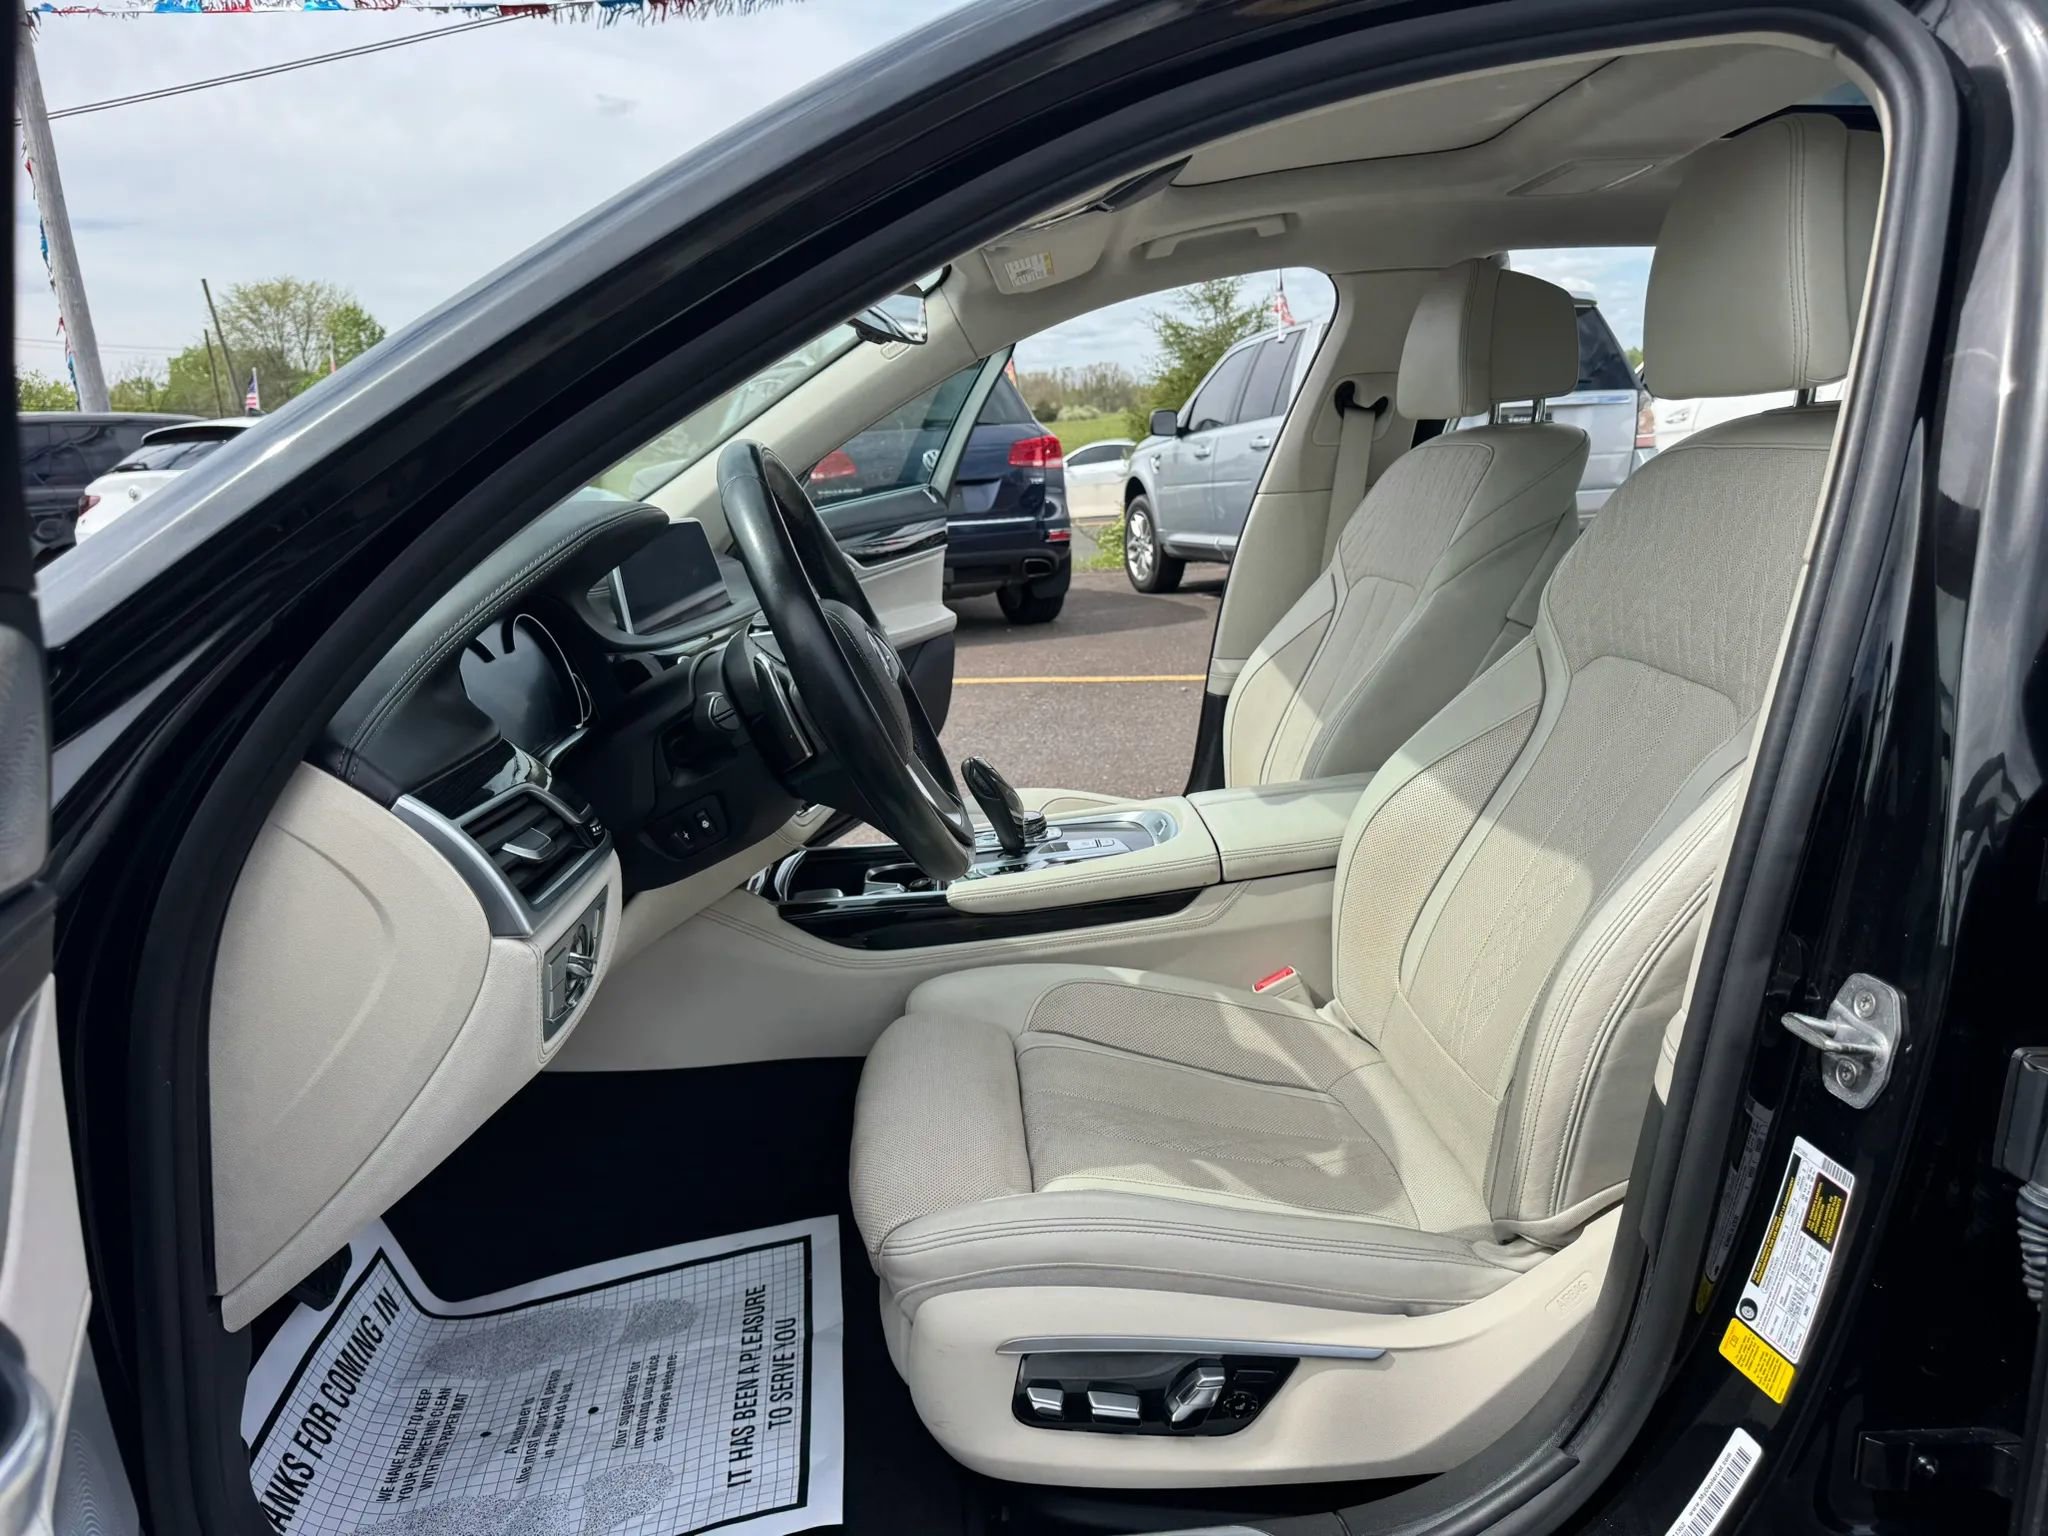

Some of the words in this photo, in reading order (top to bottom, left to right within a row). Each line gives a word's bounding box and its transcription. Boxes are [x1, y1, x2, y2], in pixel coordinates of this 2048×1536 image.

[740, 1284, 766, 1362] PLEASURE
[773, 1317, 796, 1351] YOU
[628, 1361, 641, 1373] for
[646, 1354, 660, 1385] service
[738, 1363, 760, 1375] A
[769, 1352, 795, 1402] SERVE
[544, 1369, 562, 1395] person
[643, 1385, 654, 1400] our
[260, 1452, 315, 1534] ANKS
[293, 1402, 341, 1460] FOR
[320, 1315, 384, 1408] COMING
[373, 1286, 400, 1325] IN
[415, 1389, 432, 1412] KEEP
[451, 1393, 469, 1411] MAT
[521, 1396, 535, 1406] is
[556, 1394, 570, 1404] to
[619, 1374, 639, 1426] suggestions
[654, 1392, 672, 1424] always
[733, 1378, 759, 1421] BEEN
[408, 1415, 423, 1426] TO
[440, 1413, 461, 1441] PAPER
[509, 1407, 531, 1445] customer
[528, 1397, 554, 1438] important
[552, 1405, 567, 1430] world
[631, 1400, 653, 1450] improving
[768, 1407, 793, 1430] TO
[396, 1429, 418, 1456] TRIED
[397, 1471, 419, 1502] YOUR
[409, 1420, 440, 1468] CARPETING
[431, 1388, 452, 1417] CLEAN
[545, 1431, 560, 1447] the
[611, 1429, 628, 1451] Your
[653, 1426, 665, 1442] are
[729, 1425, 755, 1463] HAS
[429, 1442, 449, 1461] THIS
[504, 1446, 518, 1454] A
[524, 1440, 540, 1464] most
[541, 1449, 556, 1459] in
[384, 1459, 406, 1483] HAVE
[419, 1464, 440, 1491] WITH
[516, 1466, 532, 1483] the
[727, 1470, 752, 1488] IT
[376, 1486, 395, 1501] WE
